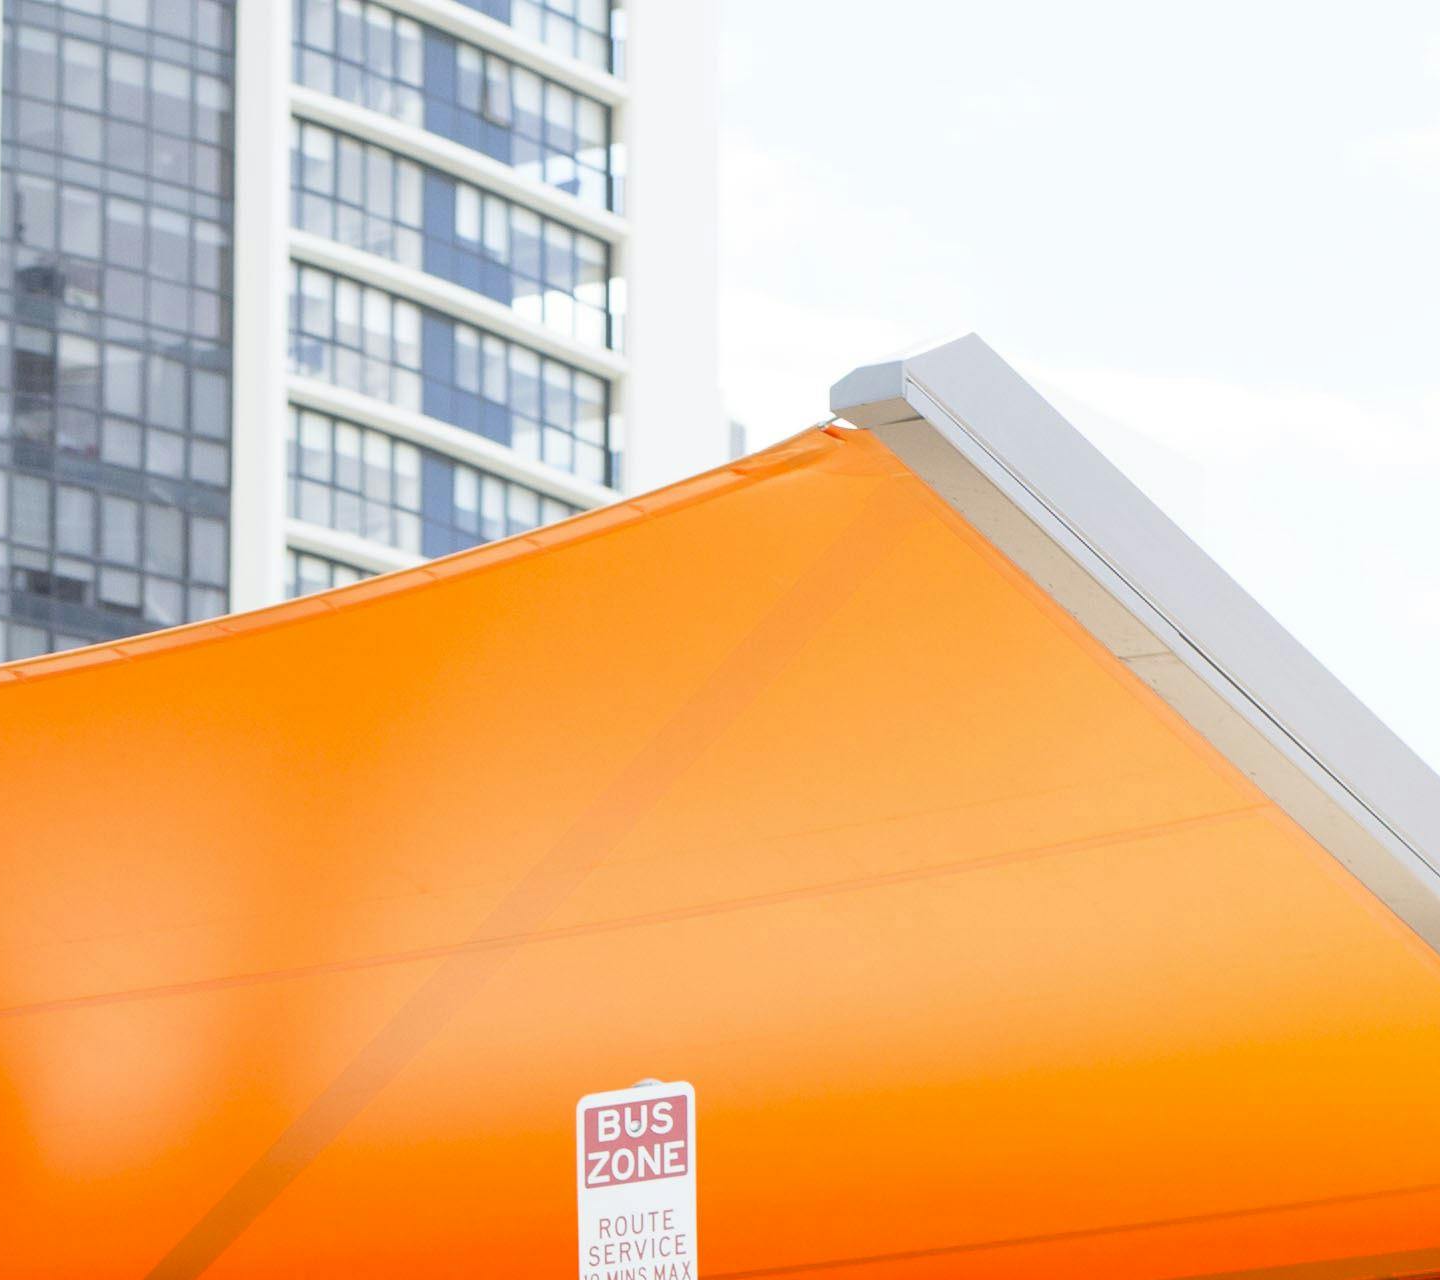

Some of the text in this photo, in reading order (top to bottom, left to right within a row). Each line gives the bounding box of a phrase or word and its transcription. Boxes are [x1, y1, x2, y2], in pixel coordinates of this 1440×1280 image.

[597, 1101, 674, 1143] BUS
[587, 1140, 686, 1185] ZONE
[599, 1209, 675, 1240] ROUTE
[588, 1234, 687, 1267] SERVICE
